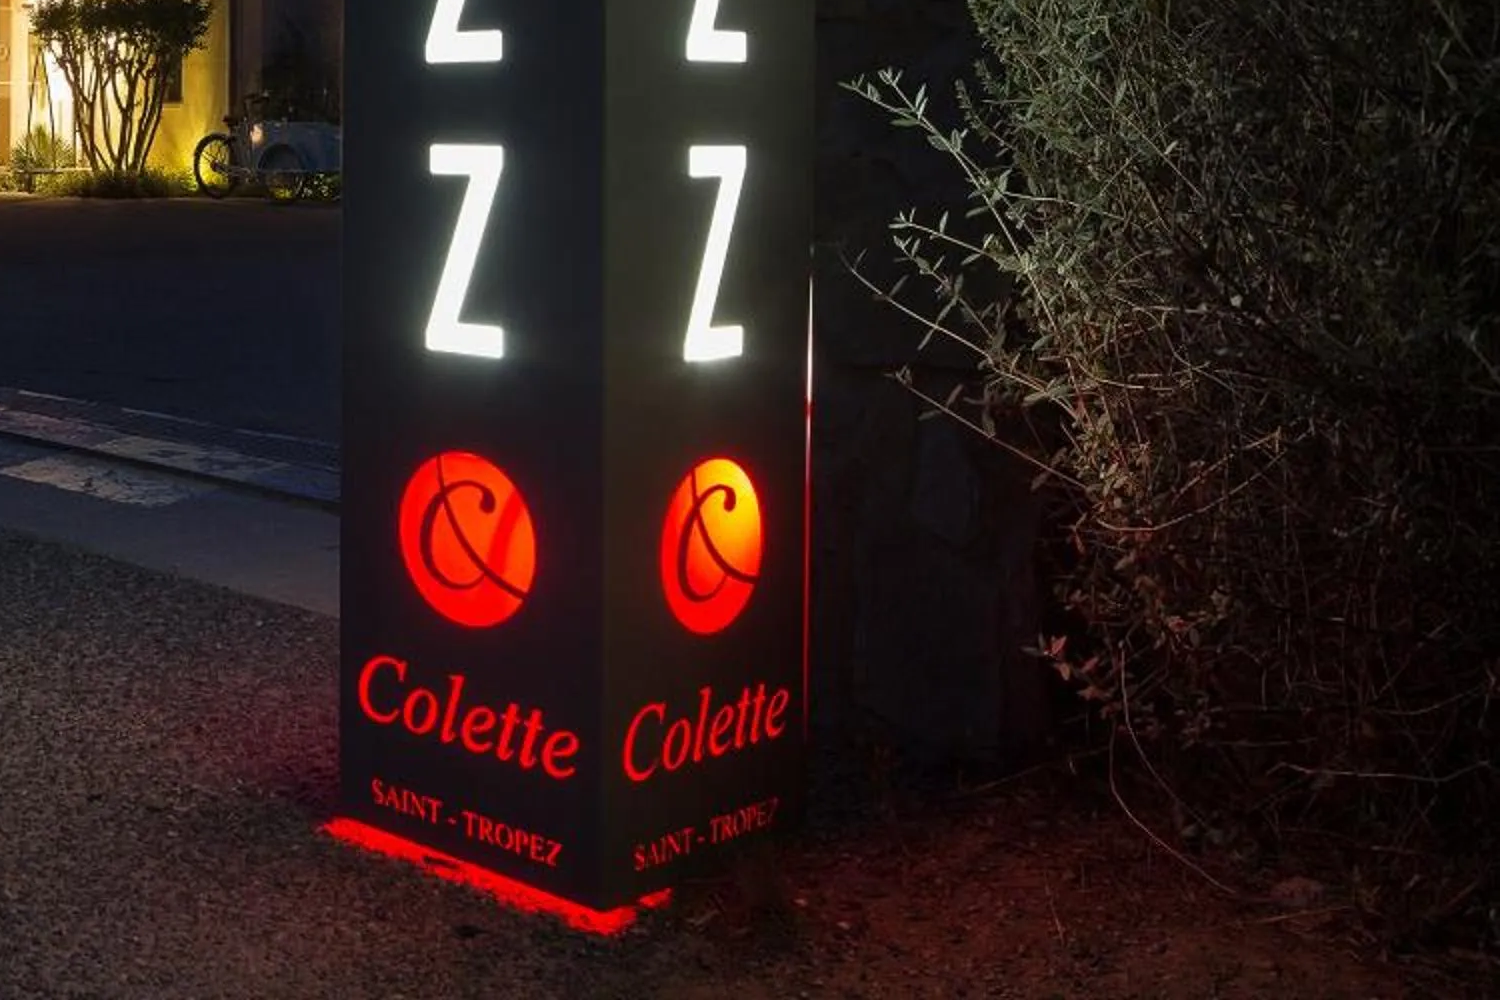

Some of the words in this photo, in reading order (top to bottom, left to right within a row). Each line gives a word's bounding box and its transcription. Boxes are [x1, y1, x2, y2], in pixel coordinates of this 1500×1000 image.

[357, 654, 580, 782] Colette
[622, 683, 789, 783] Colette
[371, 777, 444, 825] SAINT
[461, 809, 563, 867] TROPEZ
[632, 827, 694, 872] SAINT
